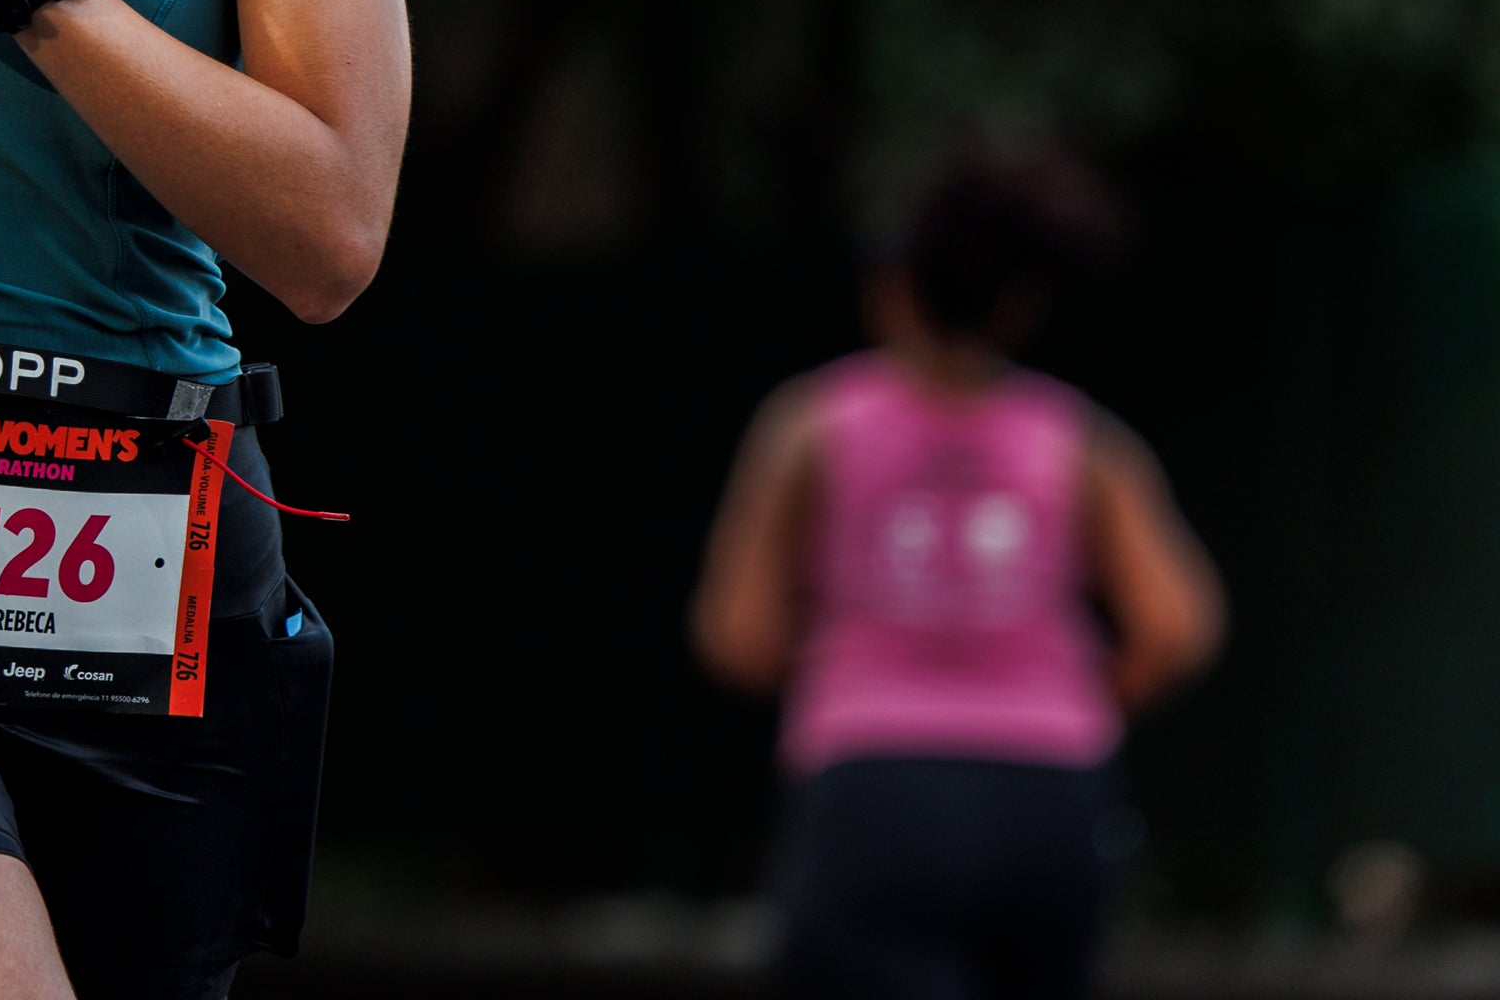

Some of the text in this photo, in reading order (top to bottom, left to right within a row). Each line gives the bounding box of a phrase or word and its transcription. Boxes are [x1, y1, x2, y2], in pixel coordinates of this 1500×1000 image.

[188, 521, 211, 551] 726
[175, 595, 199, 681] MEDALHA 726
[3, 662, 46, 681] Jeep
[77, 671, 114, 682] cosan
